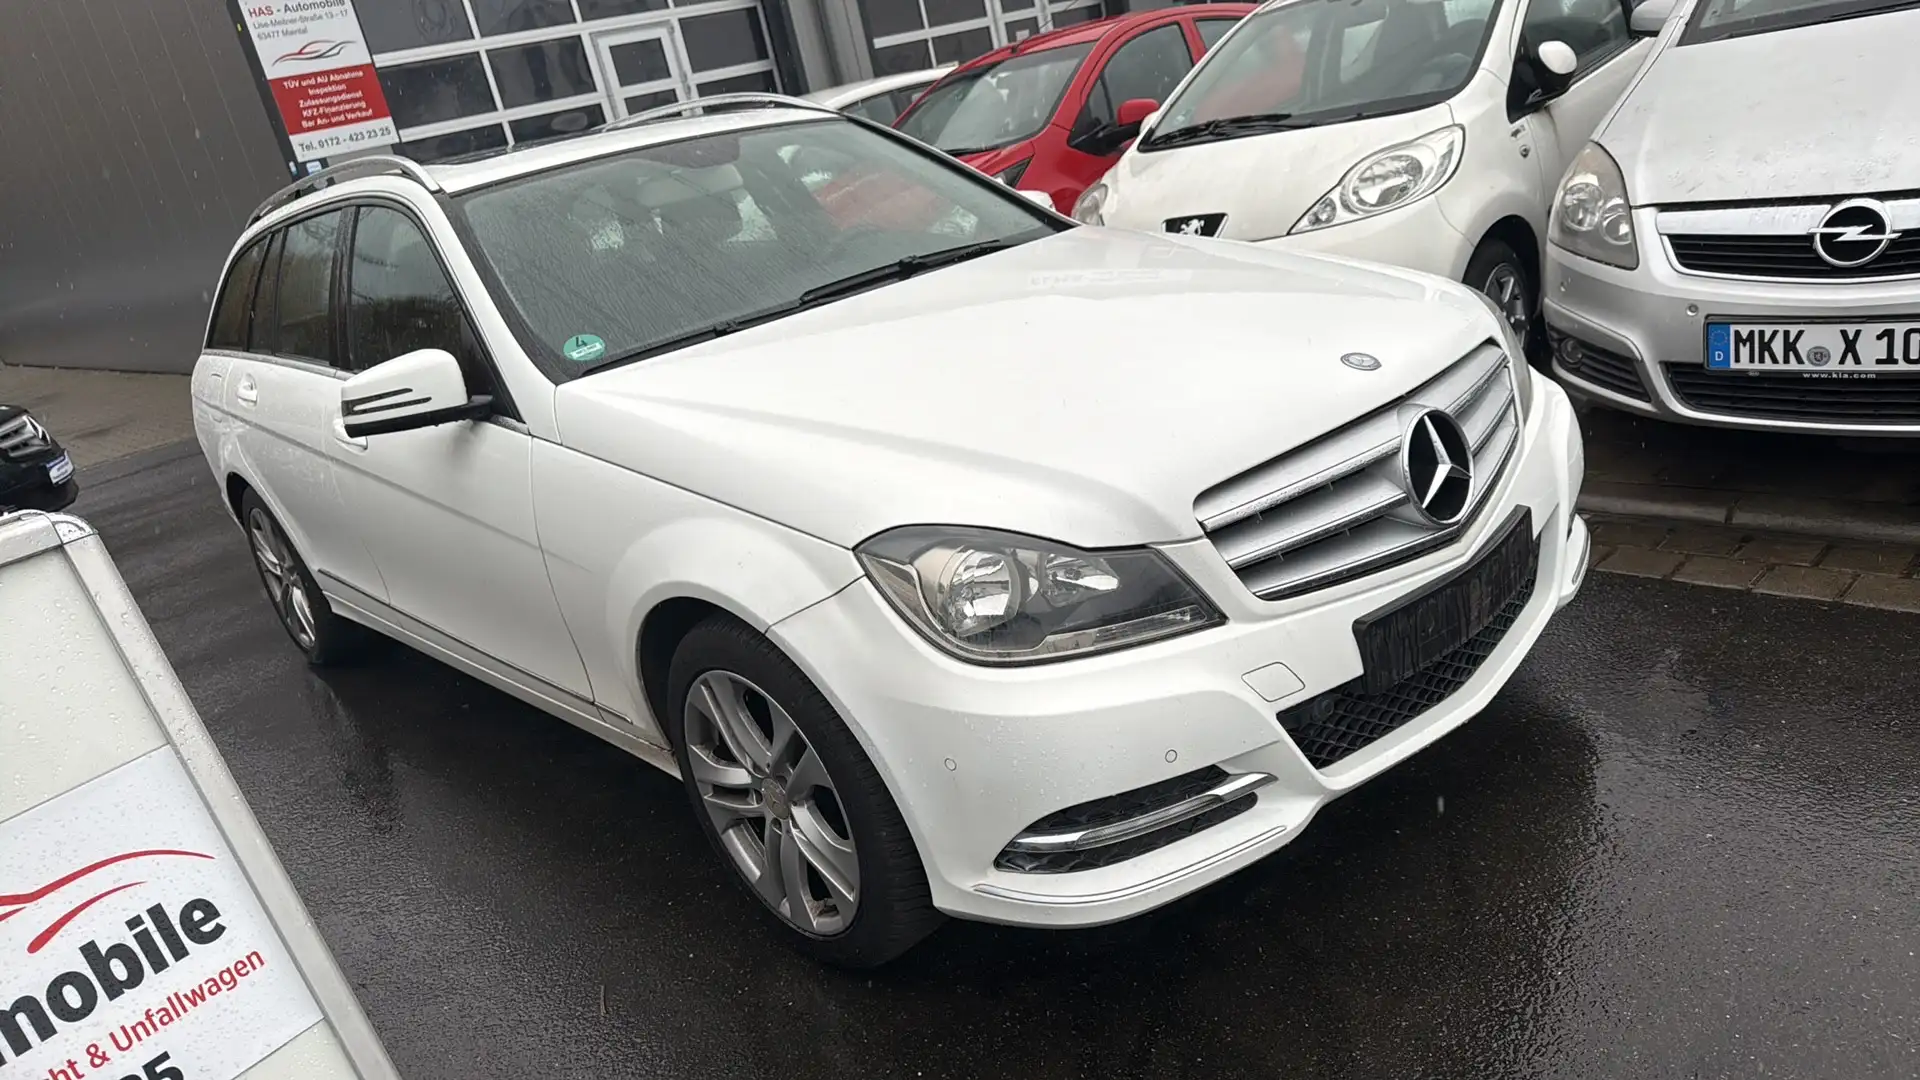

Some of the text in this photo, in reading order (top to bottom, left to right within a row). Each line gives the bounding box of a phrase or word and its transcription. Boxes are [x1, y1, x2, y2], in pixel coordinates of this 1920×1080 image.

[248, 6, 274, 18] HAS
[283, 79, 300, 89] TÜV
[300, 78, 316, 87] und
[329, 70, 364, 82] Abnahme
[307, 83, 347, 96] Inspektion
[298, 90, 363, 108] Zulassungsdienst
[331, 114, 345, 123] und
[345, 107, 373, 120] Verkauf
[298, 142, 317, 153] Tel.
[317, 136, 341, 149] 0172
[348, 131, 365, 143] 423
[366, 128, 378, 139] 23
[379, 125, 392, 136] 25
[1734, 329, 1806, 365] MKK
[1838, 328, 1862, 365] X
[1715, 351, 1724, 361] D
[1802, 371, 1877, 379] www.kia.com
[85, 1043, 110, 1068] &
[109, 949, 265, 1052] Unfallwagen
